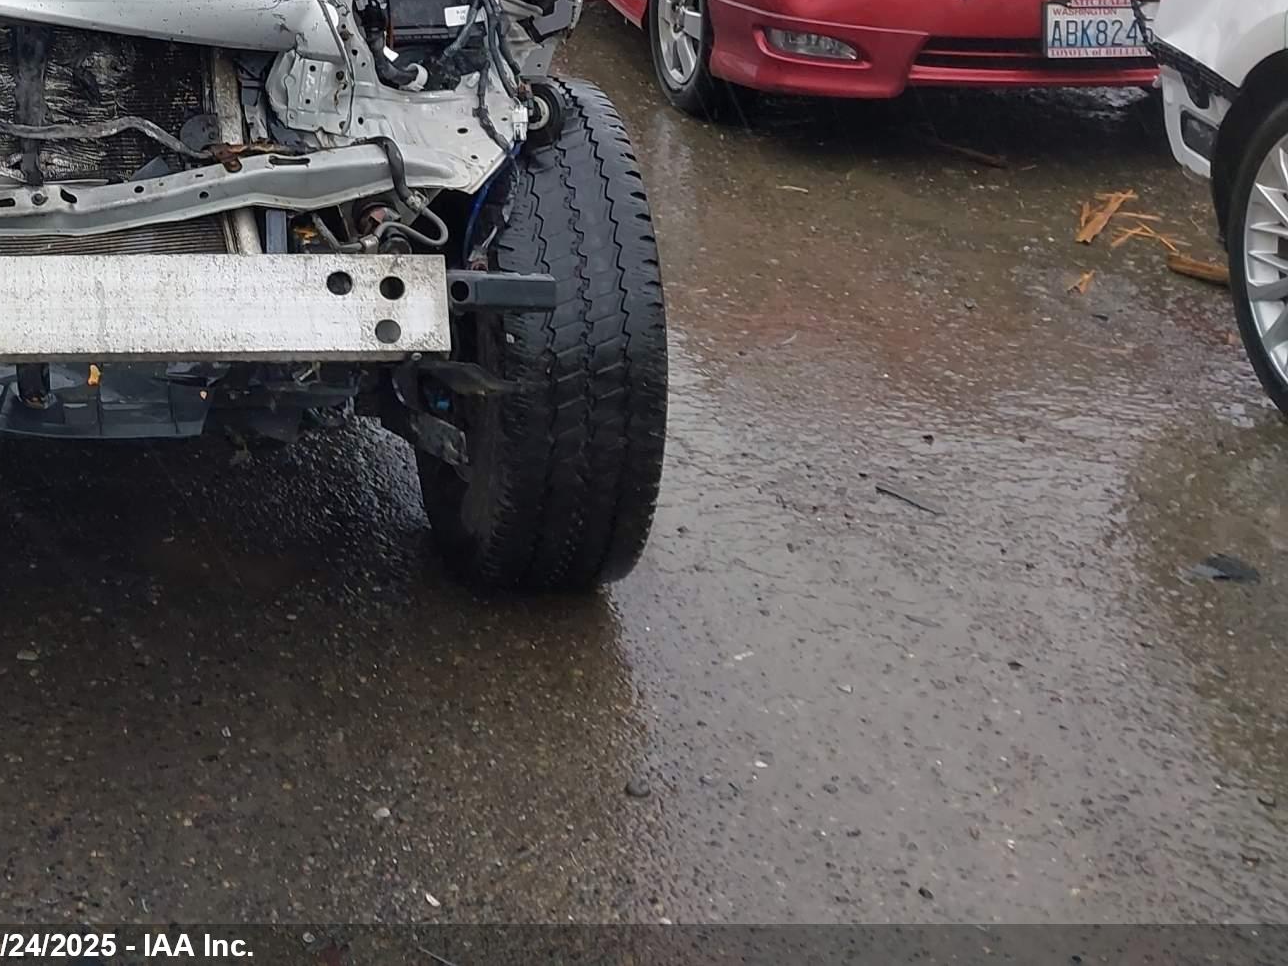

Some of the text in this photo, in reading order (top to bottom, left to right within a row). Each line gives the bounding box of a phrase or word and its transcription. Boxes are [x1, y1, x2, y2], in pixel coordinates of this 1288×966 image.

[1052, 7, 1117, 16] WASHINGTON
[1050, 48, 1090, 57] TOYOTA
[1105, 47, 1147, 56] BELLEV
